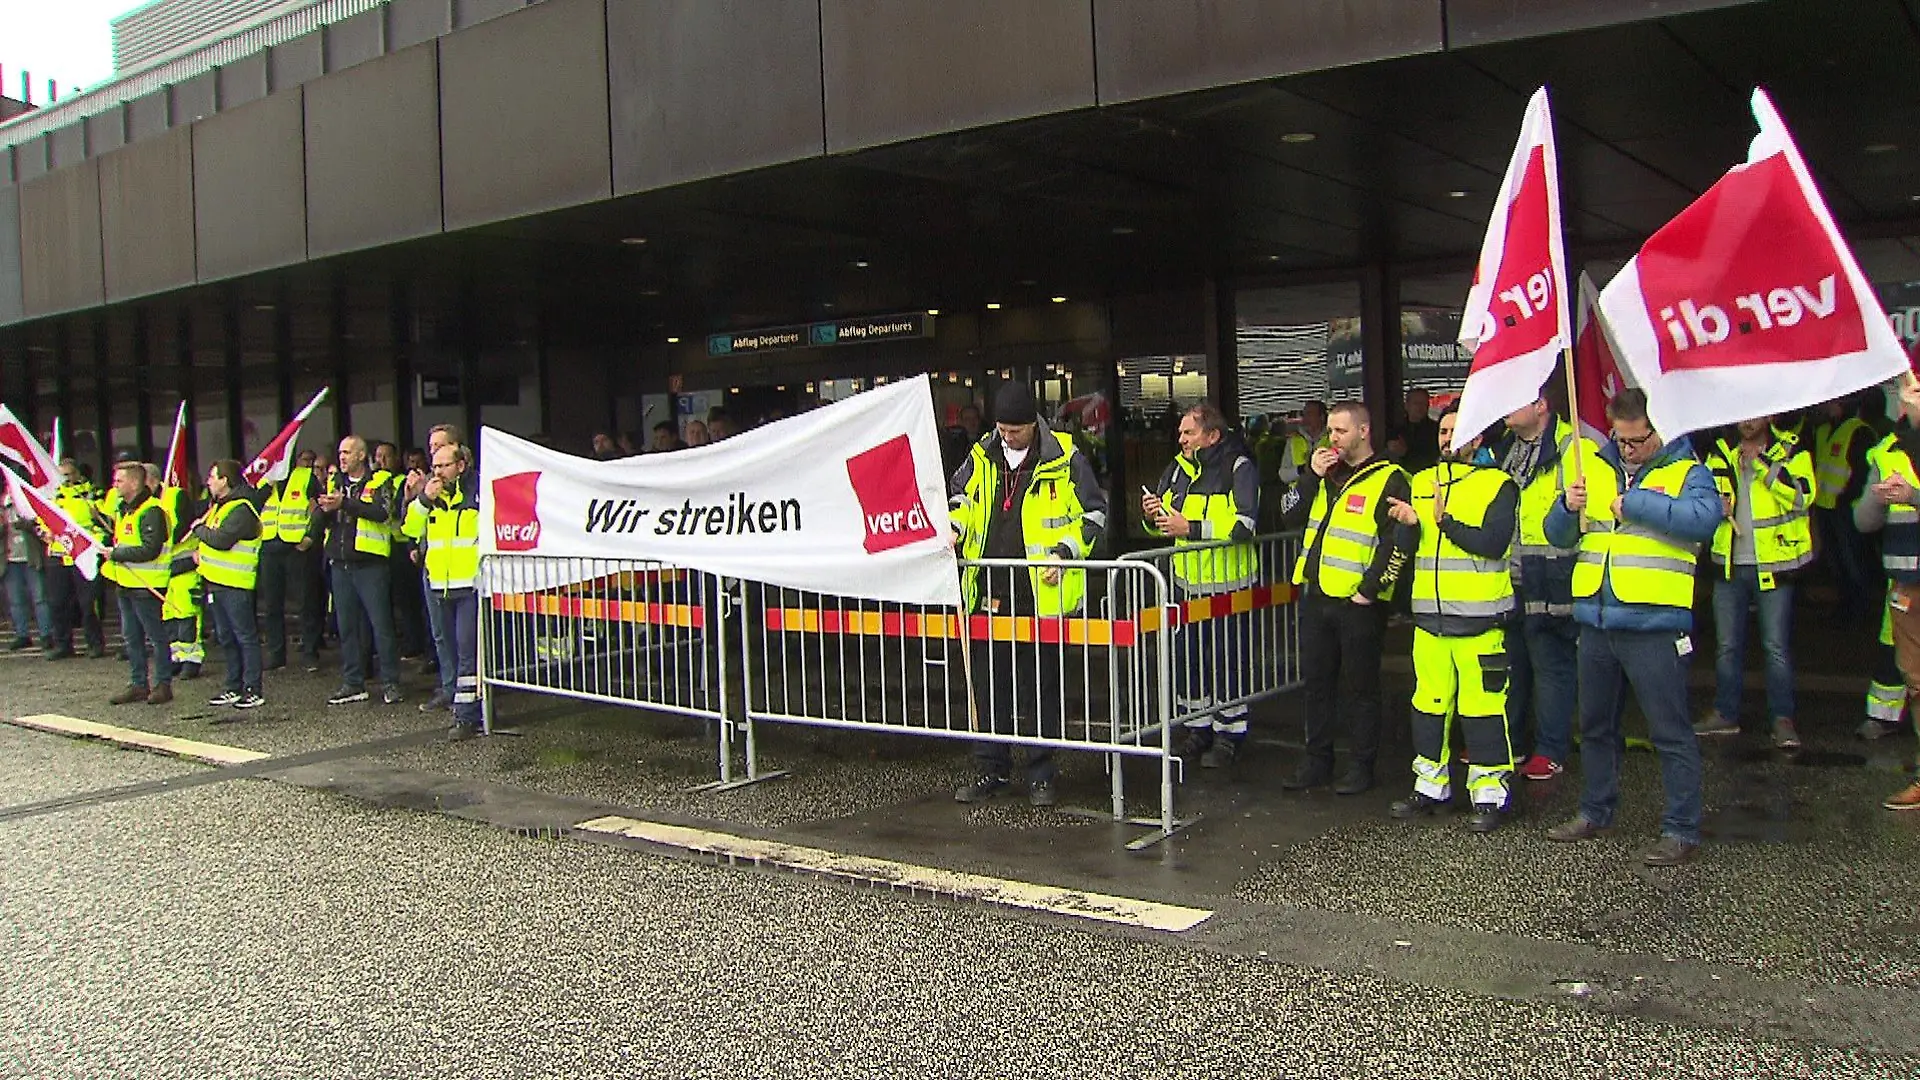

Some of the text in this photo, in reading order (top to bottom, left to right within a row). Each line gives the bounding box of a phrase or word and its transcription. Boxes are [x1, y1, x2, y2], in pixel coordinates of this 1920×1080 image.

[733, 331, 799, 349] Abflug Departures
[839, 322, 912, 338] Abflug Departures
[585, 492, 801, 535] Wir streiken
[867, 502, 929, 535] ver.di
[496, 521, 538, 541] ver.di
